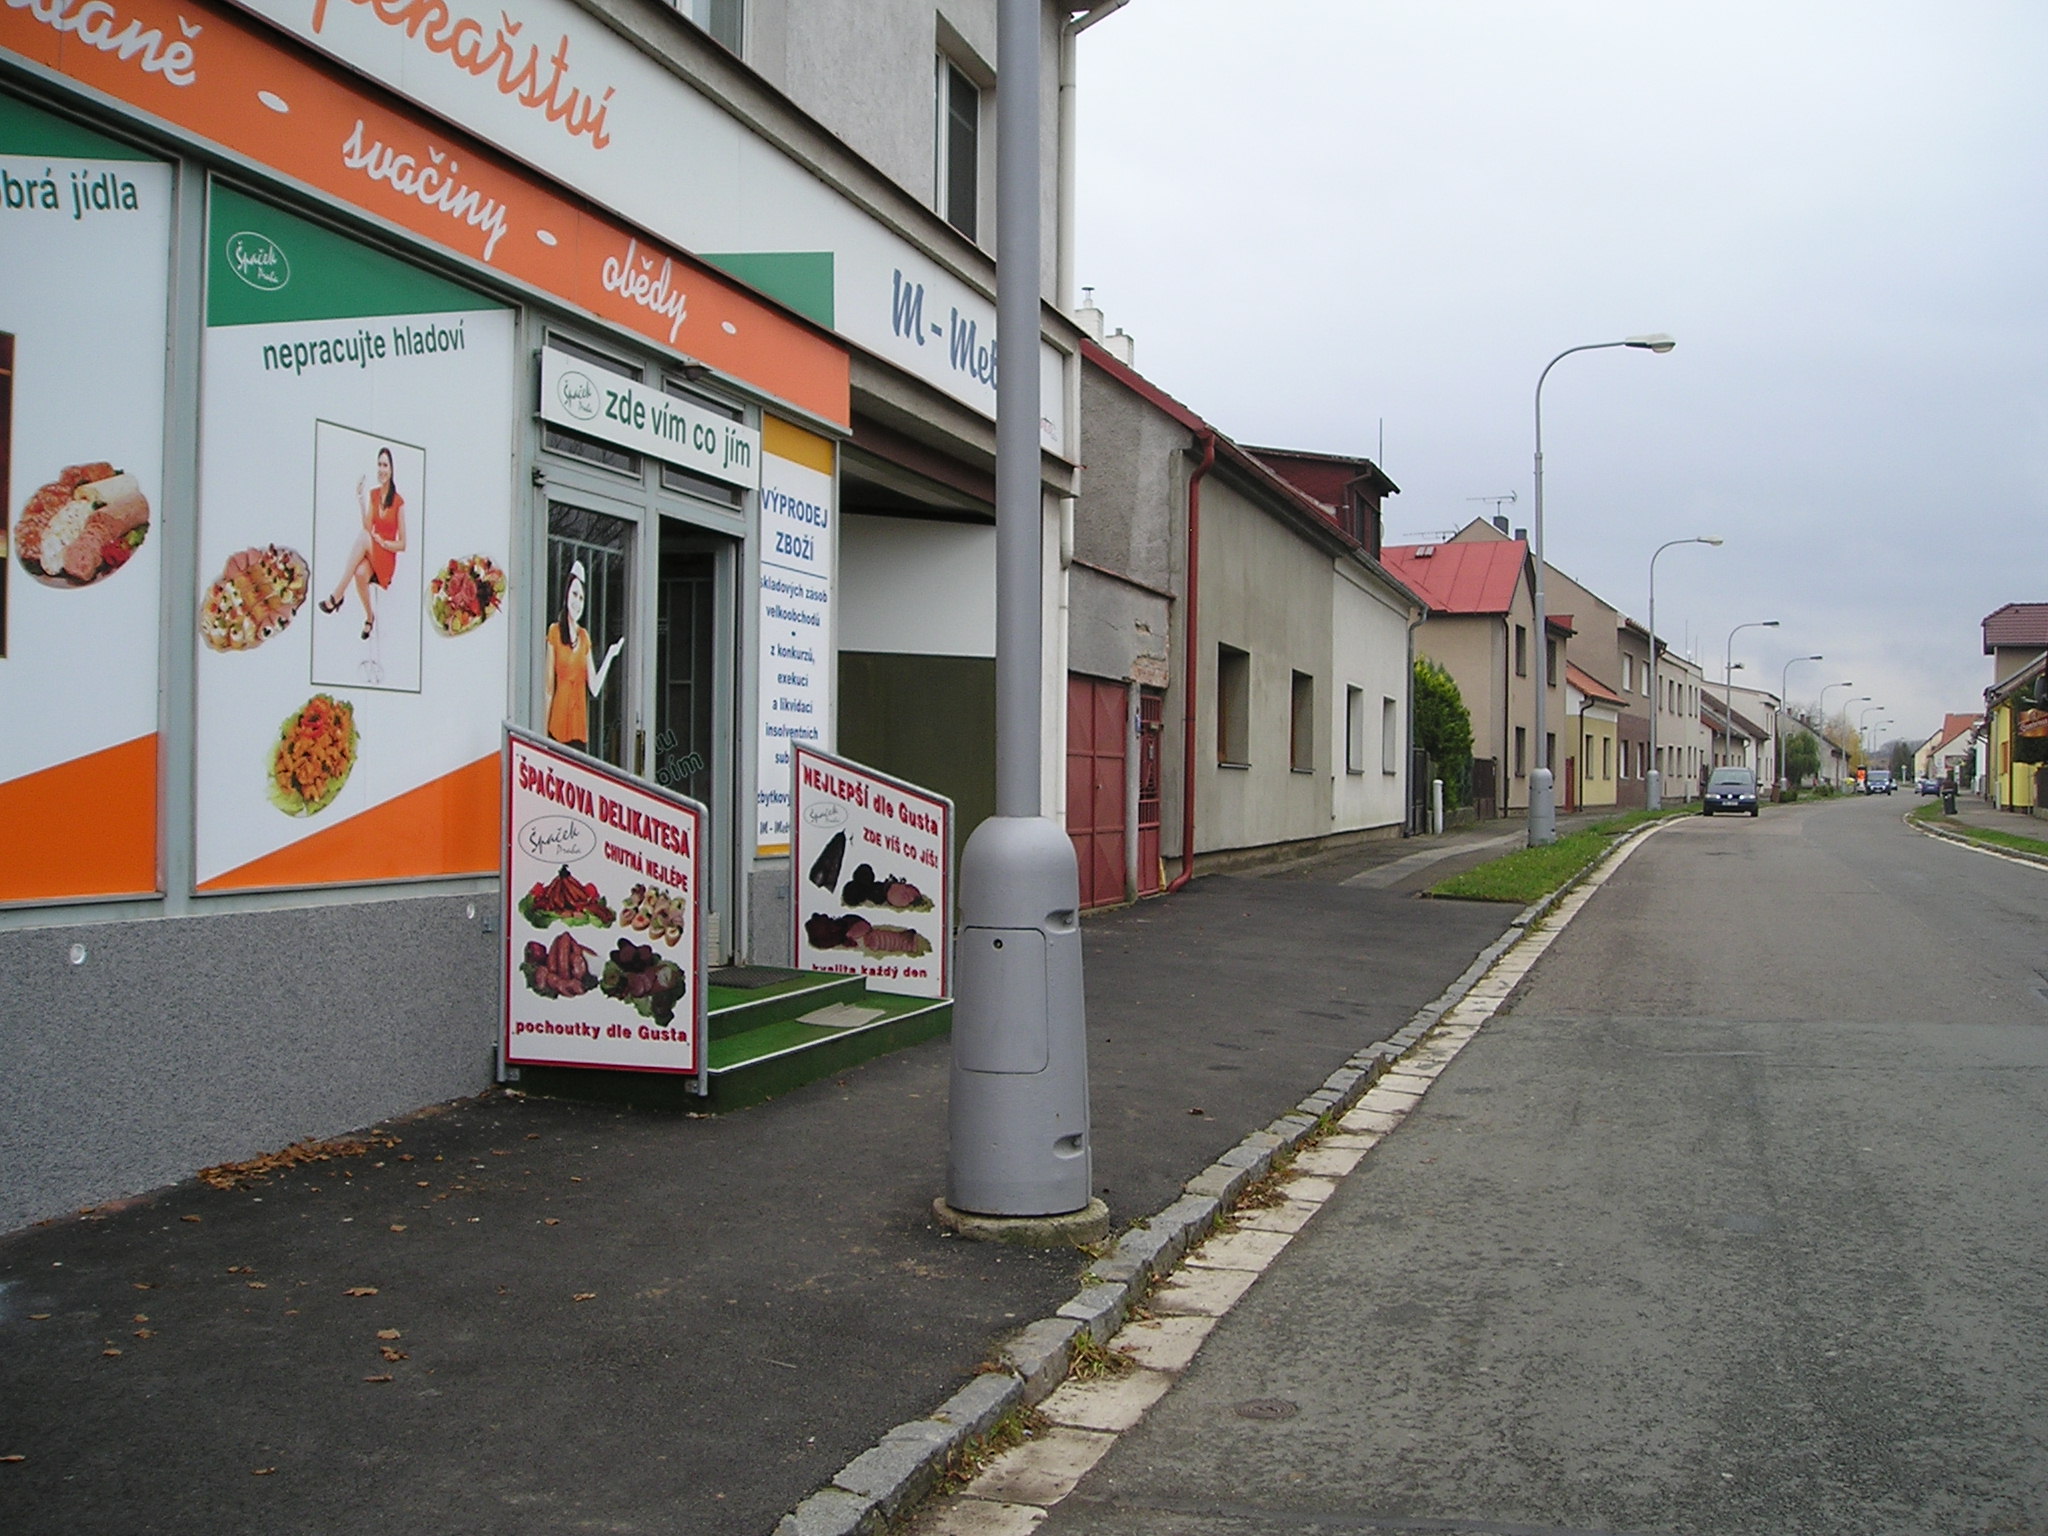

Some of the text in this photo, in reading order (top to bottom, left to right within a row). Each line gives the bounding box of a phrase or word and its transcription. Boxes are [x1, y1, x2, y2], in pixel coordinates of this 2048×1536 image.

[0, 167, 138, 220] brá jídla
[343, 119, 507, 262] svačiny
[602, 237, 687, 344] obědy
[263, 319, 465, 376] nepracujte hladoví
[605, 388, 750, 469] zde vím co jím
[761, 487, 828, 528] VÝPRODEJ
[776, 531, 814, 561] ZBOŽÍ
[772, 699, 778, 710] a
[519, 756, 690, 859] ŠPAČKOVA DELIKATESA
[803, 764, 938, 836] NEJLEPŠÍ dle Gusta
[529, 821, 579, 854] Špaček
[863, 827, 938, 868] ZDE VÍŠ CO JÍŠ!
[604, 841, 688, 893] CHUTNÁ NEJLÉPE
[861, 965, 898, 979] každý
[903, 967, 928, 978] den
[516, 1020, 688, 1042] pochoutky dle Gusta
